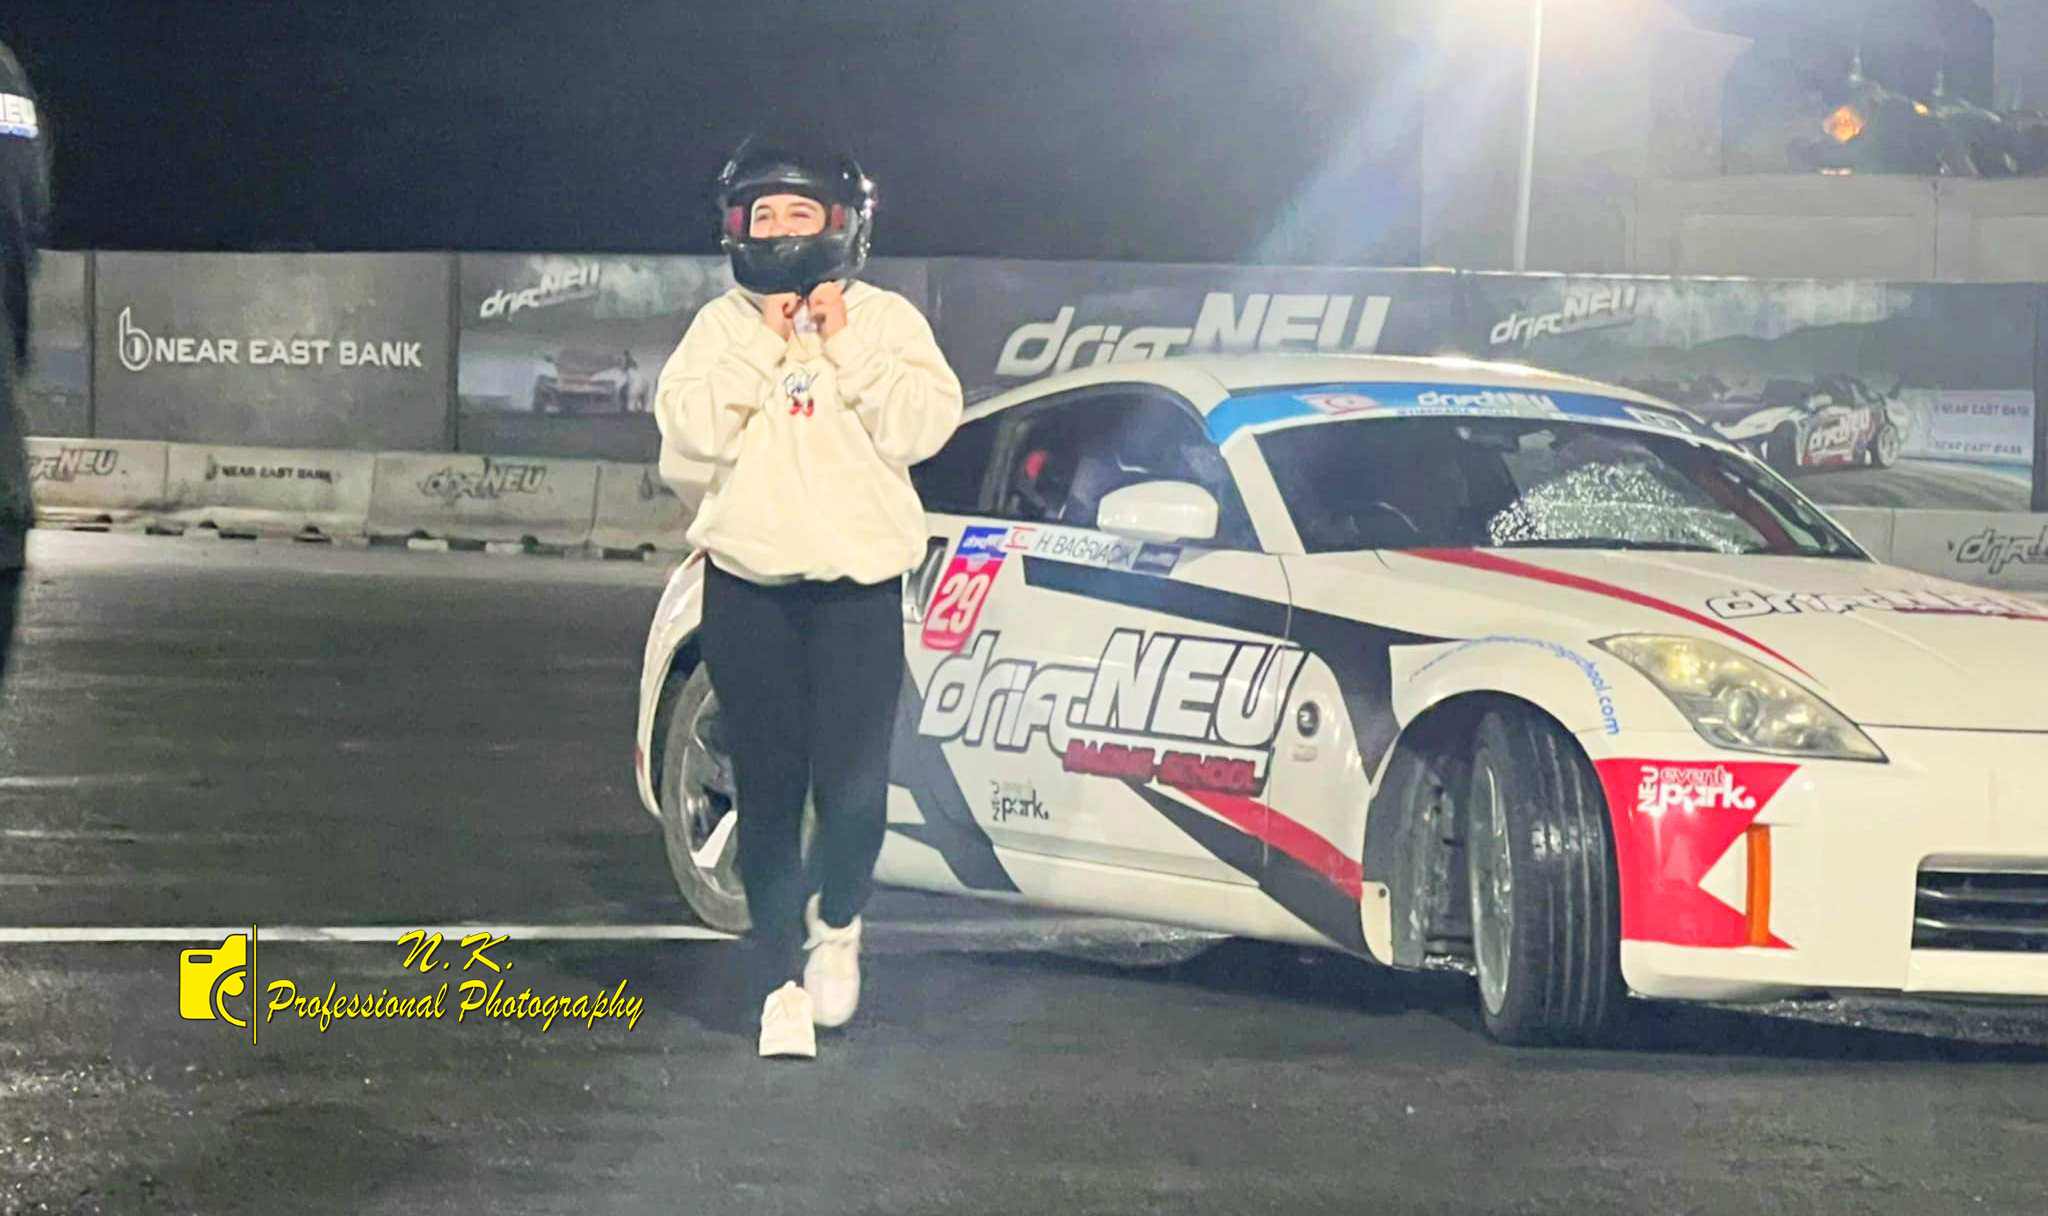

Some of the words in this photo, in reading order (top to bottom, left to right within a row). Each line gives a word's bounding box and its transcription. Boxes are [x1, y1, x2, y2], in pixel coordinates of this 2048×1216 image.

[155, 337, 240, 363] NEAR
[249, 338, 330, 365] EAST
[339, 341, 423, 368] BANK
[926, 572, 991, 635] 29
[918, 627, 1303, 755] driftNEU
[1636, 764, 1659, 812] NEU
[1660, 765, 1729, 787] event
